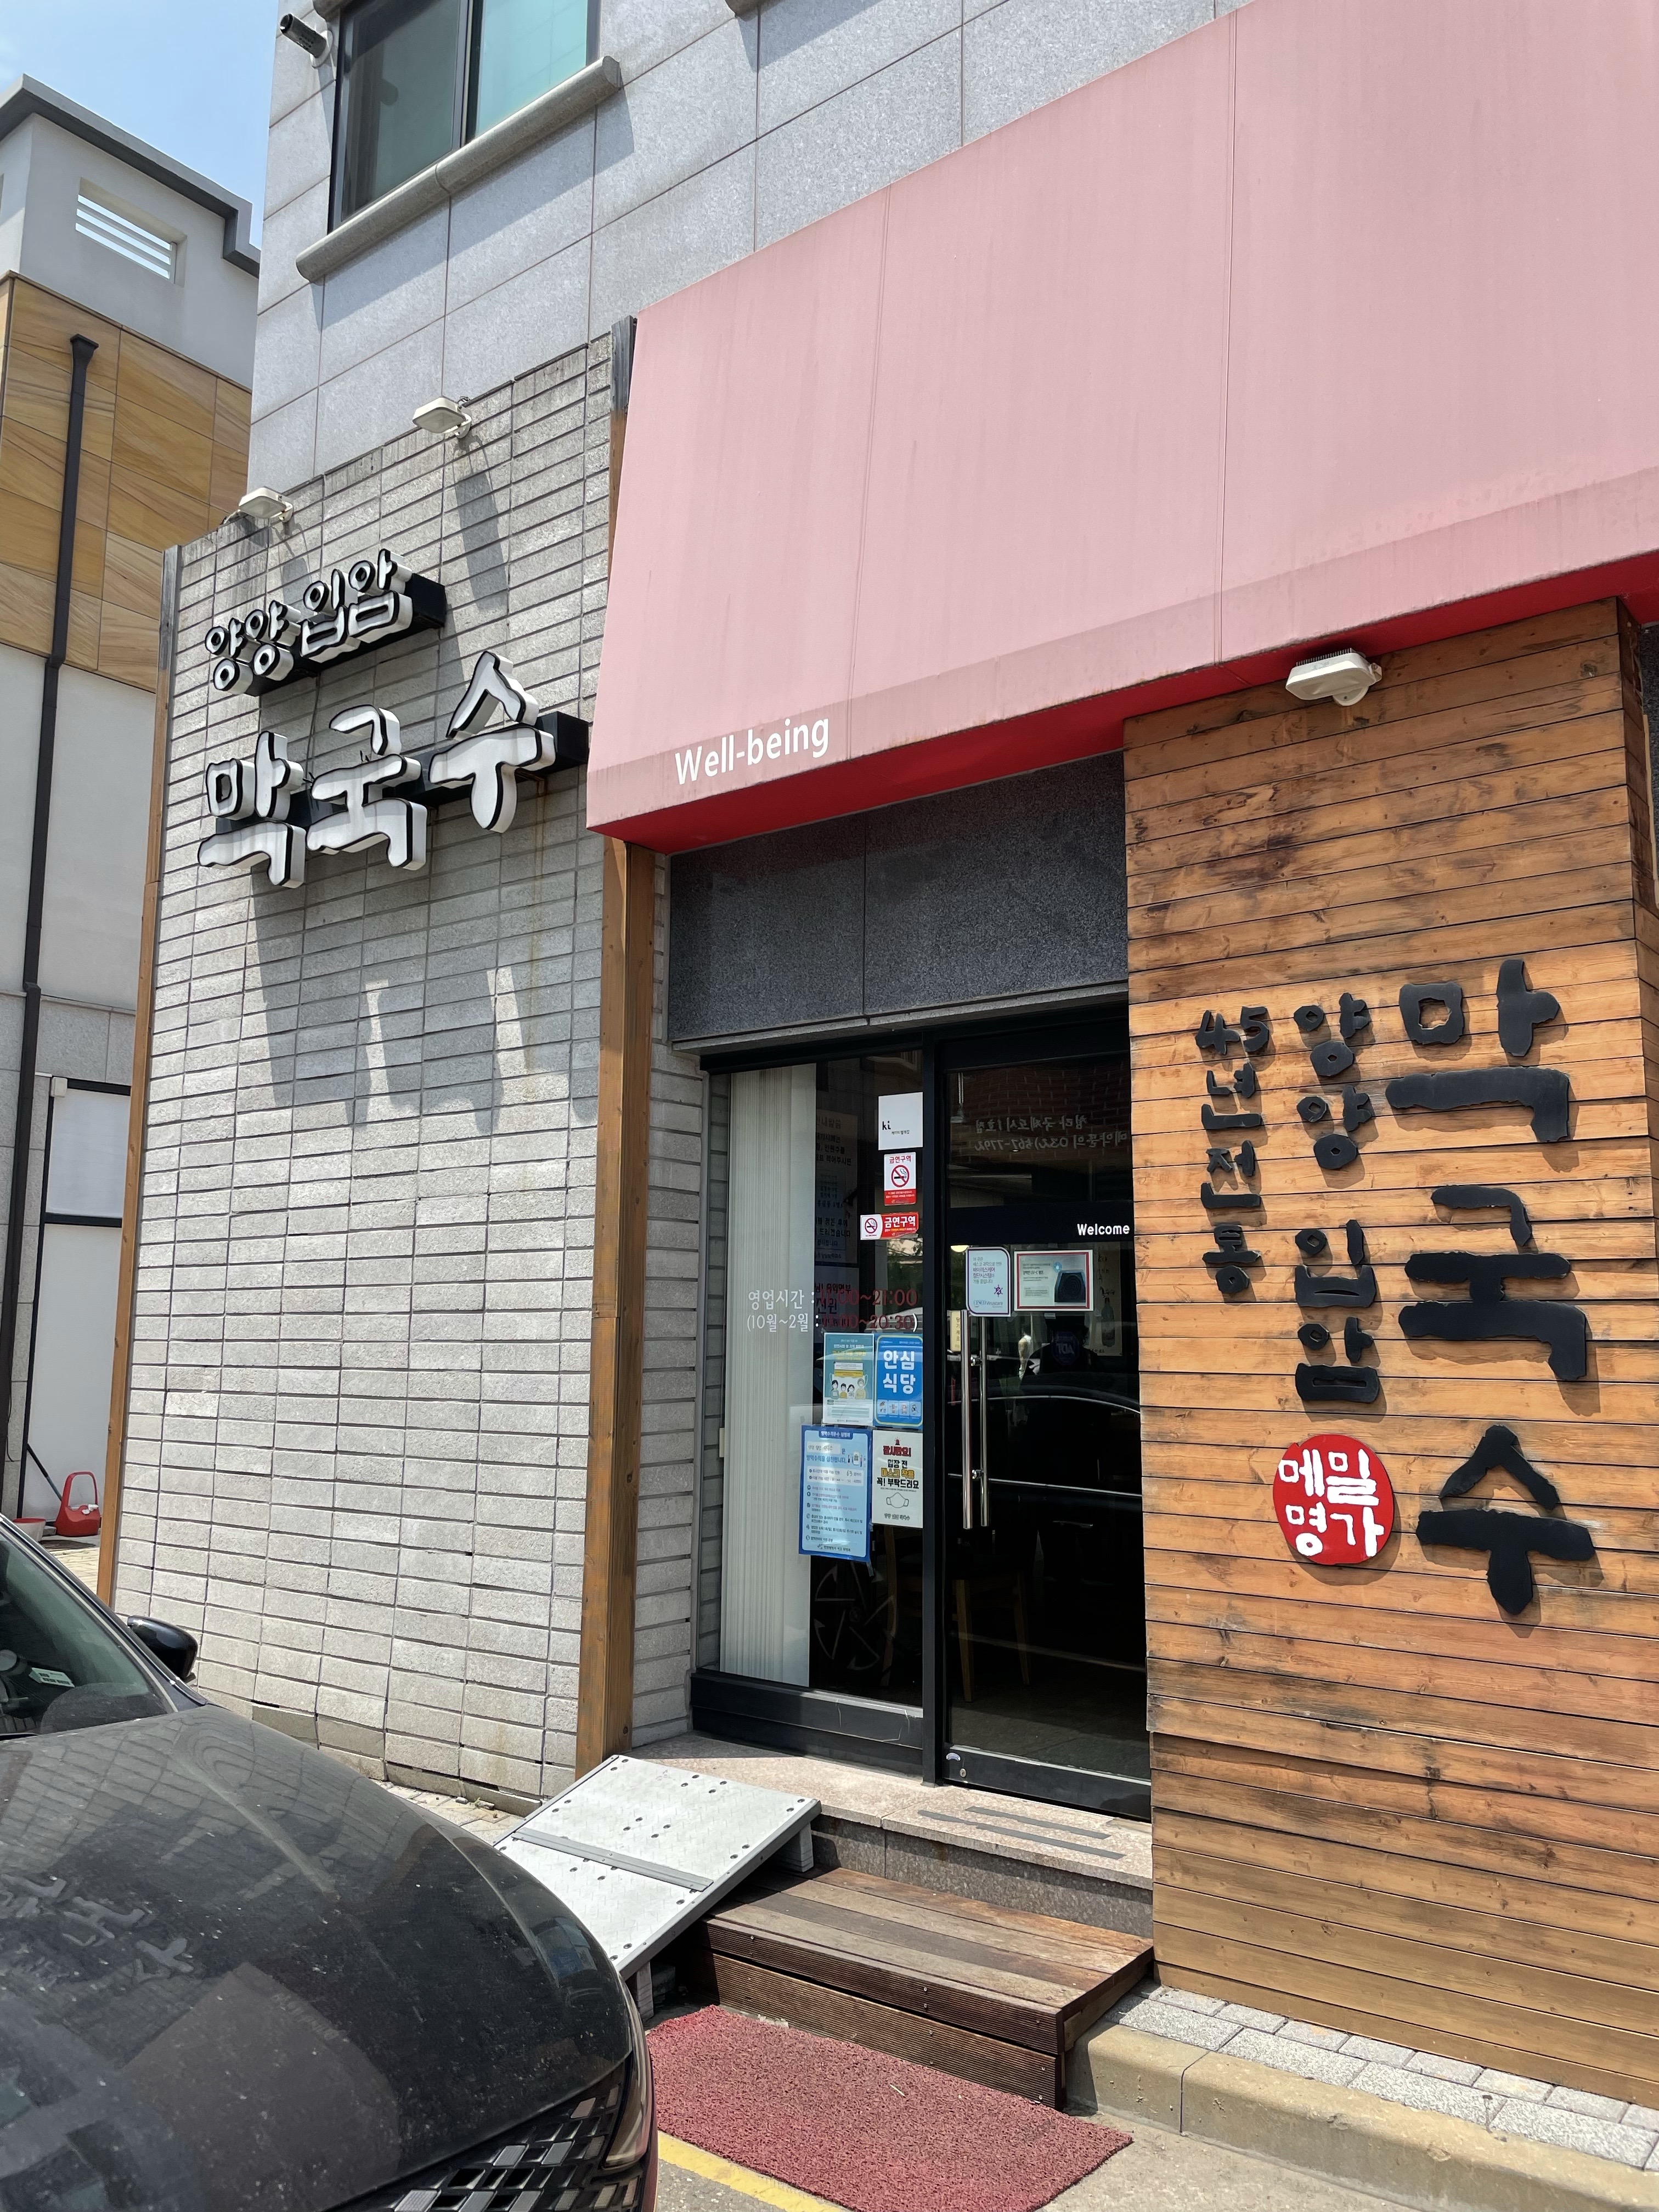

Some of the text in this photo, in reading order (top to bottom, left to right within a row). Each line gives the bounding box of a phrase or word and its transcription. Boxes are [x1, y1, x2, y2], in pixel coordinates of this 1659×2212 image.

[205, 549, 414, 694] 양양 입암
[675, 718, 829, 785] Well-being
[198, 651, 556, 888] 막국수
[889, 1155, 911, 1164] 금연구역
[1293, 992, 1379, 1404] 양양 입암
[884, 1216, 916, 1228] 금연구역
[1077, 1223, 1130, 1235] Welcome
[1385, 959, 1595, 1615] 막국수
[748, 1290, 805, 1310] 영업시간
[747, 1313, 809, 1333] (10월~2월
[883, 1350, 915, 1370] 안심
[883, 1373, 916, 1394] 식당
[881, 1468, 915, 1480] 마스크 착용
[888, 1459, 907, 1469] 입장 전
[888, 1478, 919, 1489] 부탁드려요
[1278, 1448, 1380, 1506] 메밀
[1285, 1501, 1385, 1557] 명가
